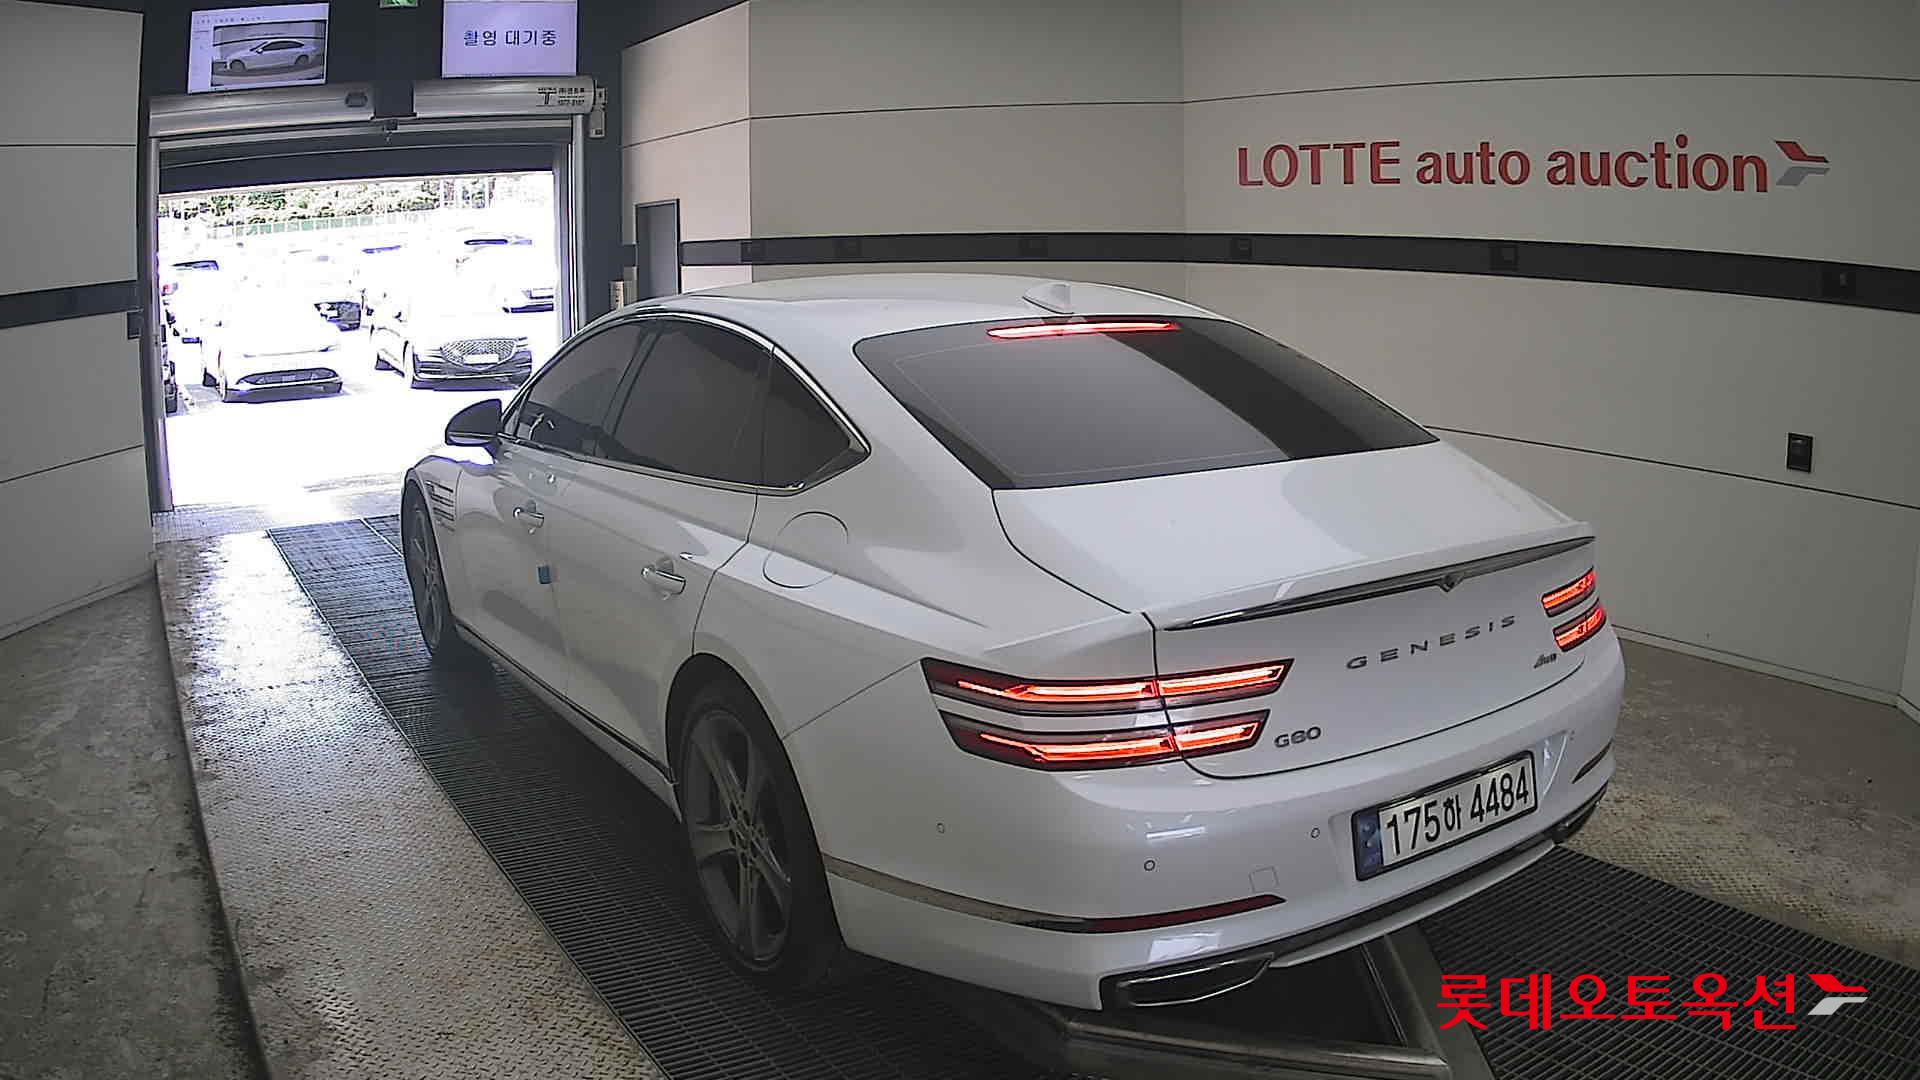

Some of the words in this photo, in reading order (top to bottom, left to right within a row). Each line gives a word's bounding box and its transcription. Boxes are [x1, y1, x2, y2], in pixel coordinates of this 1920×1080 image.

[463, 30, 497, 47] 촬영
[505, 29, 557, 46] 대기중
[1238, 142, 1401, 187] LOTTE
[1417, 142, 1530, 185] auto
[1547, 134, 1768, 192] auction
[1346, 615, 1516, 670] GENESIS
[1386, 792, 1463, 856] 175하
[1470, 766, 1530, 823] 4484
